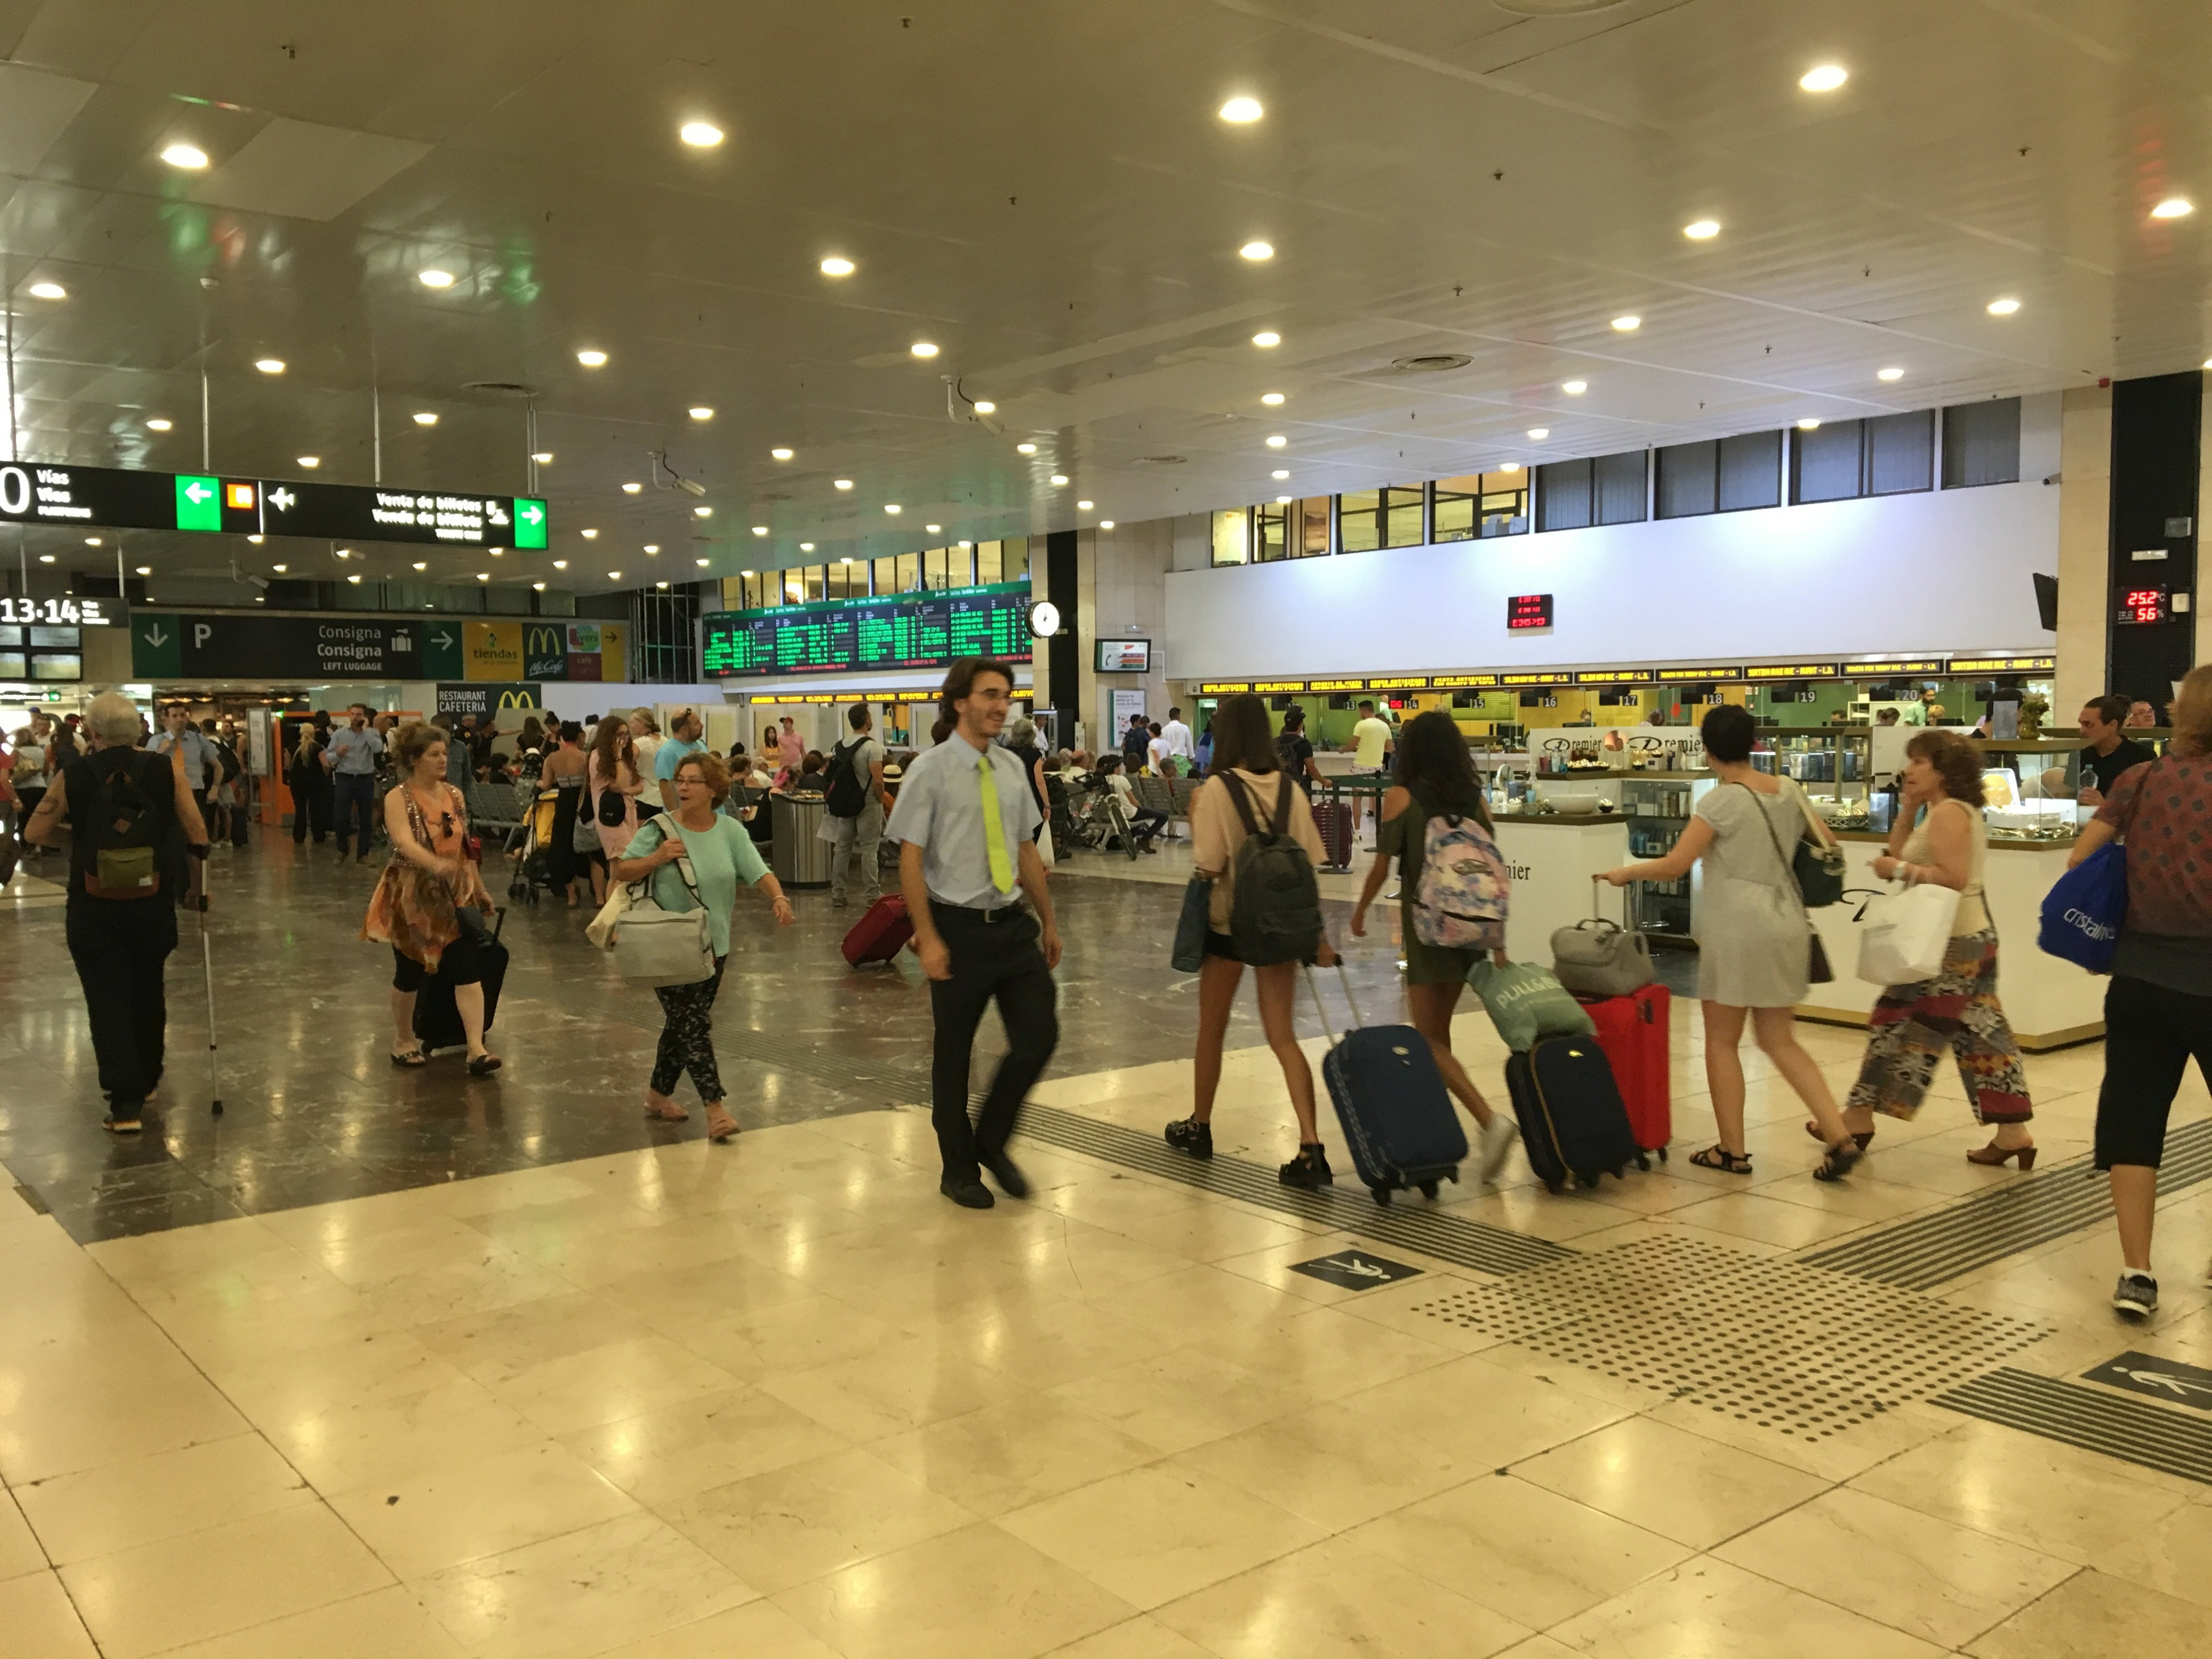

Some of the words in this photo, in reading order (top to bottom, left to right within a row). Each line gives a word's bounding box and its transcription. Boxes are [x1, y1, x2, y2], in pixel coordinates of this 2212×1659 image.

[377, 493, 414, 508] Venta
[417, 495, 434, 509] de
[436, 497, 482, 512] billetes
[2137, 607, 2157, 620] 56
[194, 623, 212, 649] P
[318, 625, 382, 642] Consigna
[317, 643, 382, 659] Consigna
[473, 649, 518, 659] tiendas
[323, 662, 341, 671] LEFT
[344, 662, 382, 671] LUGGAGE
[439, 690, 487, 701] RESTAURANT
[1624, 695, 1637, 706] 17
[1709, 693, 1722, 704] 18
[1801, 691, 1815, 702] 19
[1902, 689, 1918, 701] 20
[439, 702, 487, 713] CAFETERIA
[1346, 701, 1355, 709] 13
[1408, 700, 1418, 708] 14
[1473, 698, 1484, 708] 15
[1545, 697, 1556, 707] 16
